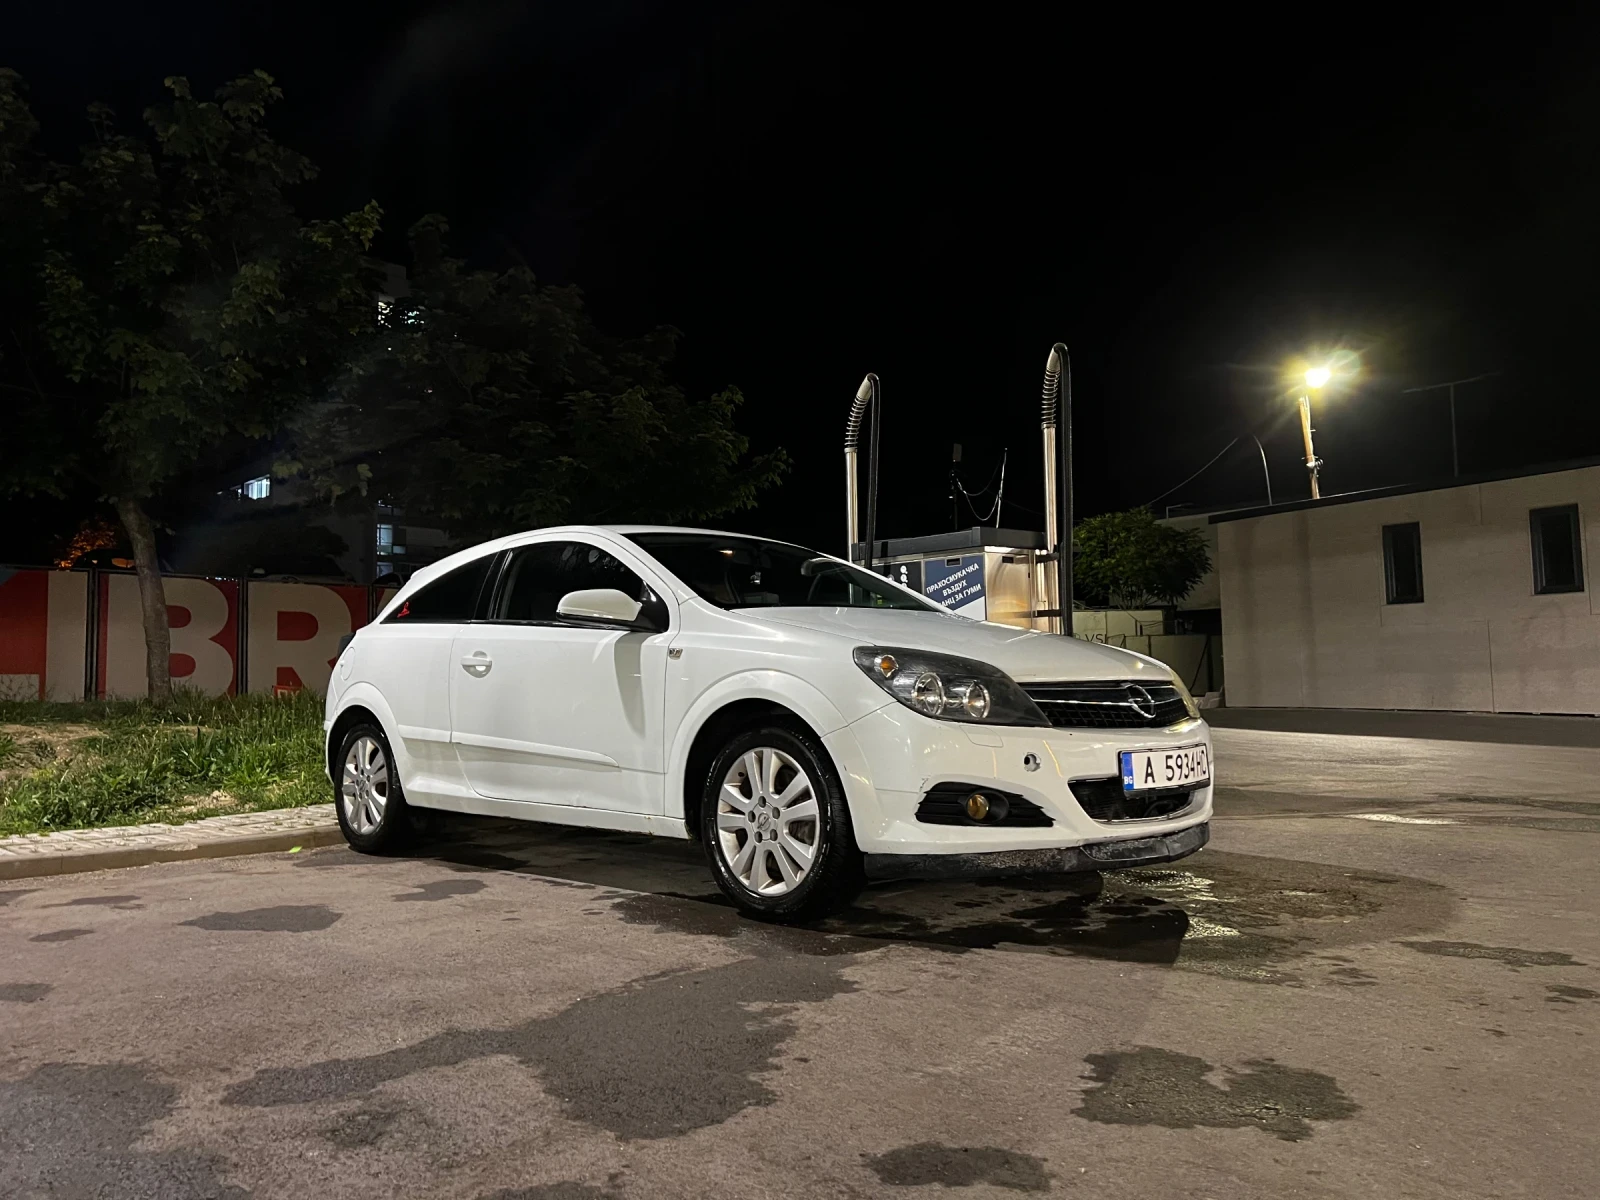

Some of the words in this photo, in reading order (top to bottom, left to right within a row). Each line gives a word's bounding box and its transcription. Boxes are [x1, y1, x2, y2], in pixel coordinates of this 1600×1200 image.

[926, 562, 980, 594] ПРАХОСМУКАЧКА
[942, 579, 968, 597] ВЪЗДУХ
[940, 595, 956, 607] АНЦ
[954, 592, 964, 602] ЗА
[963, 583, 982, 597] ГУМИ
[1123, 775, 1134, 785] BG
[1144, 756, 1155, 784] A
